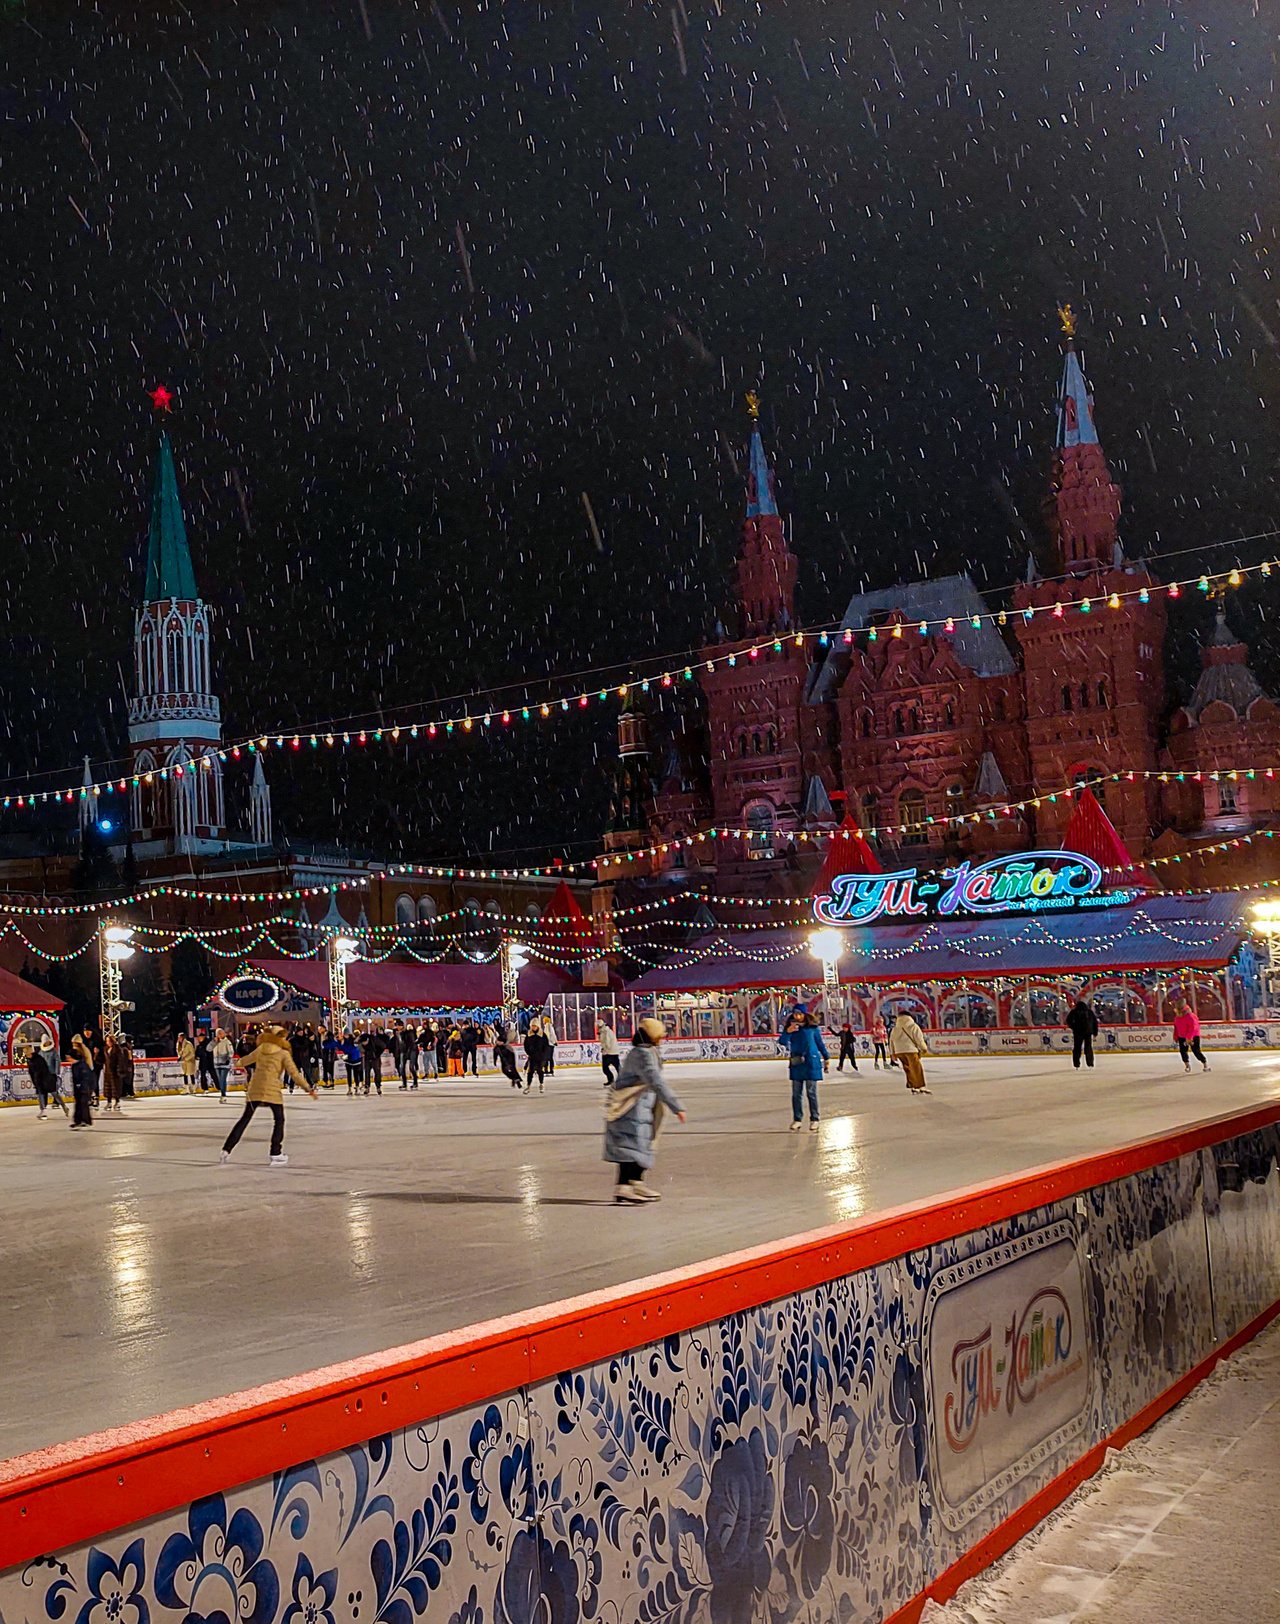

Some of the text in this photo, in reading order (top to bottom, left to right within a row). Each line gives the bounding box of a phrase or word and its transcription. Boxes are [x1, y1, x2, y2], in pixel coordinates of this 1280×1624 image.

[235, 988, 263, 999] КАФЕ
[1001, 1037, 1029, 1046] KION
[1128, 1034, 1161, 1043] BOSCO
